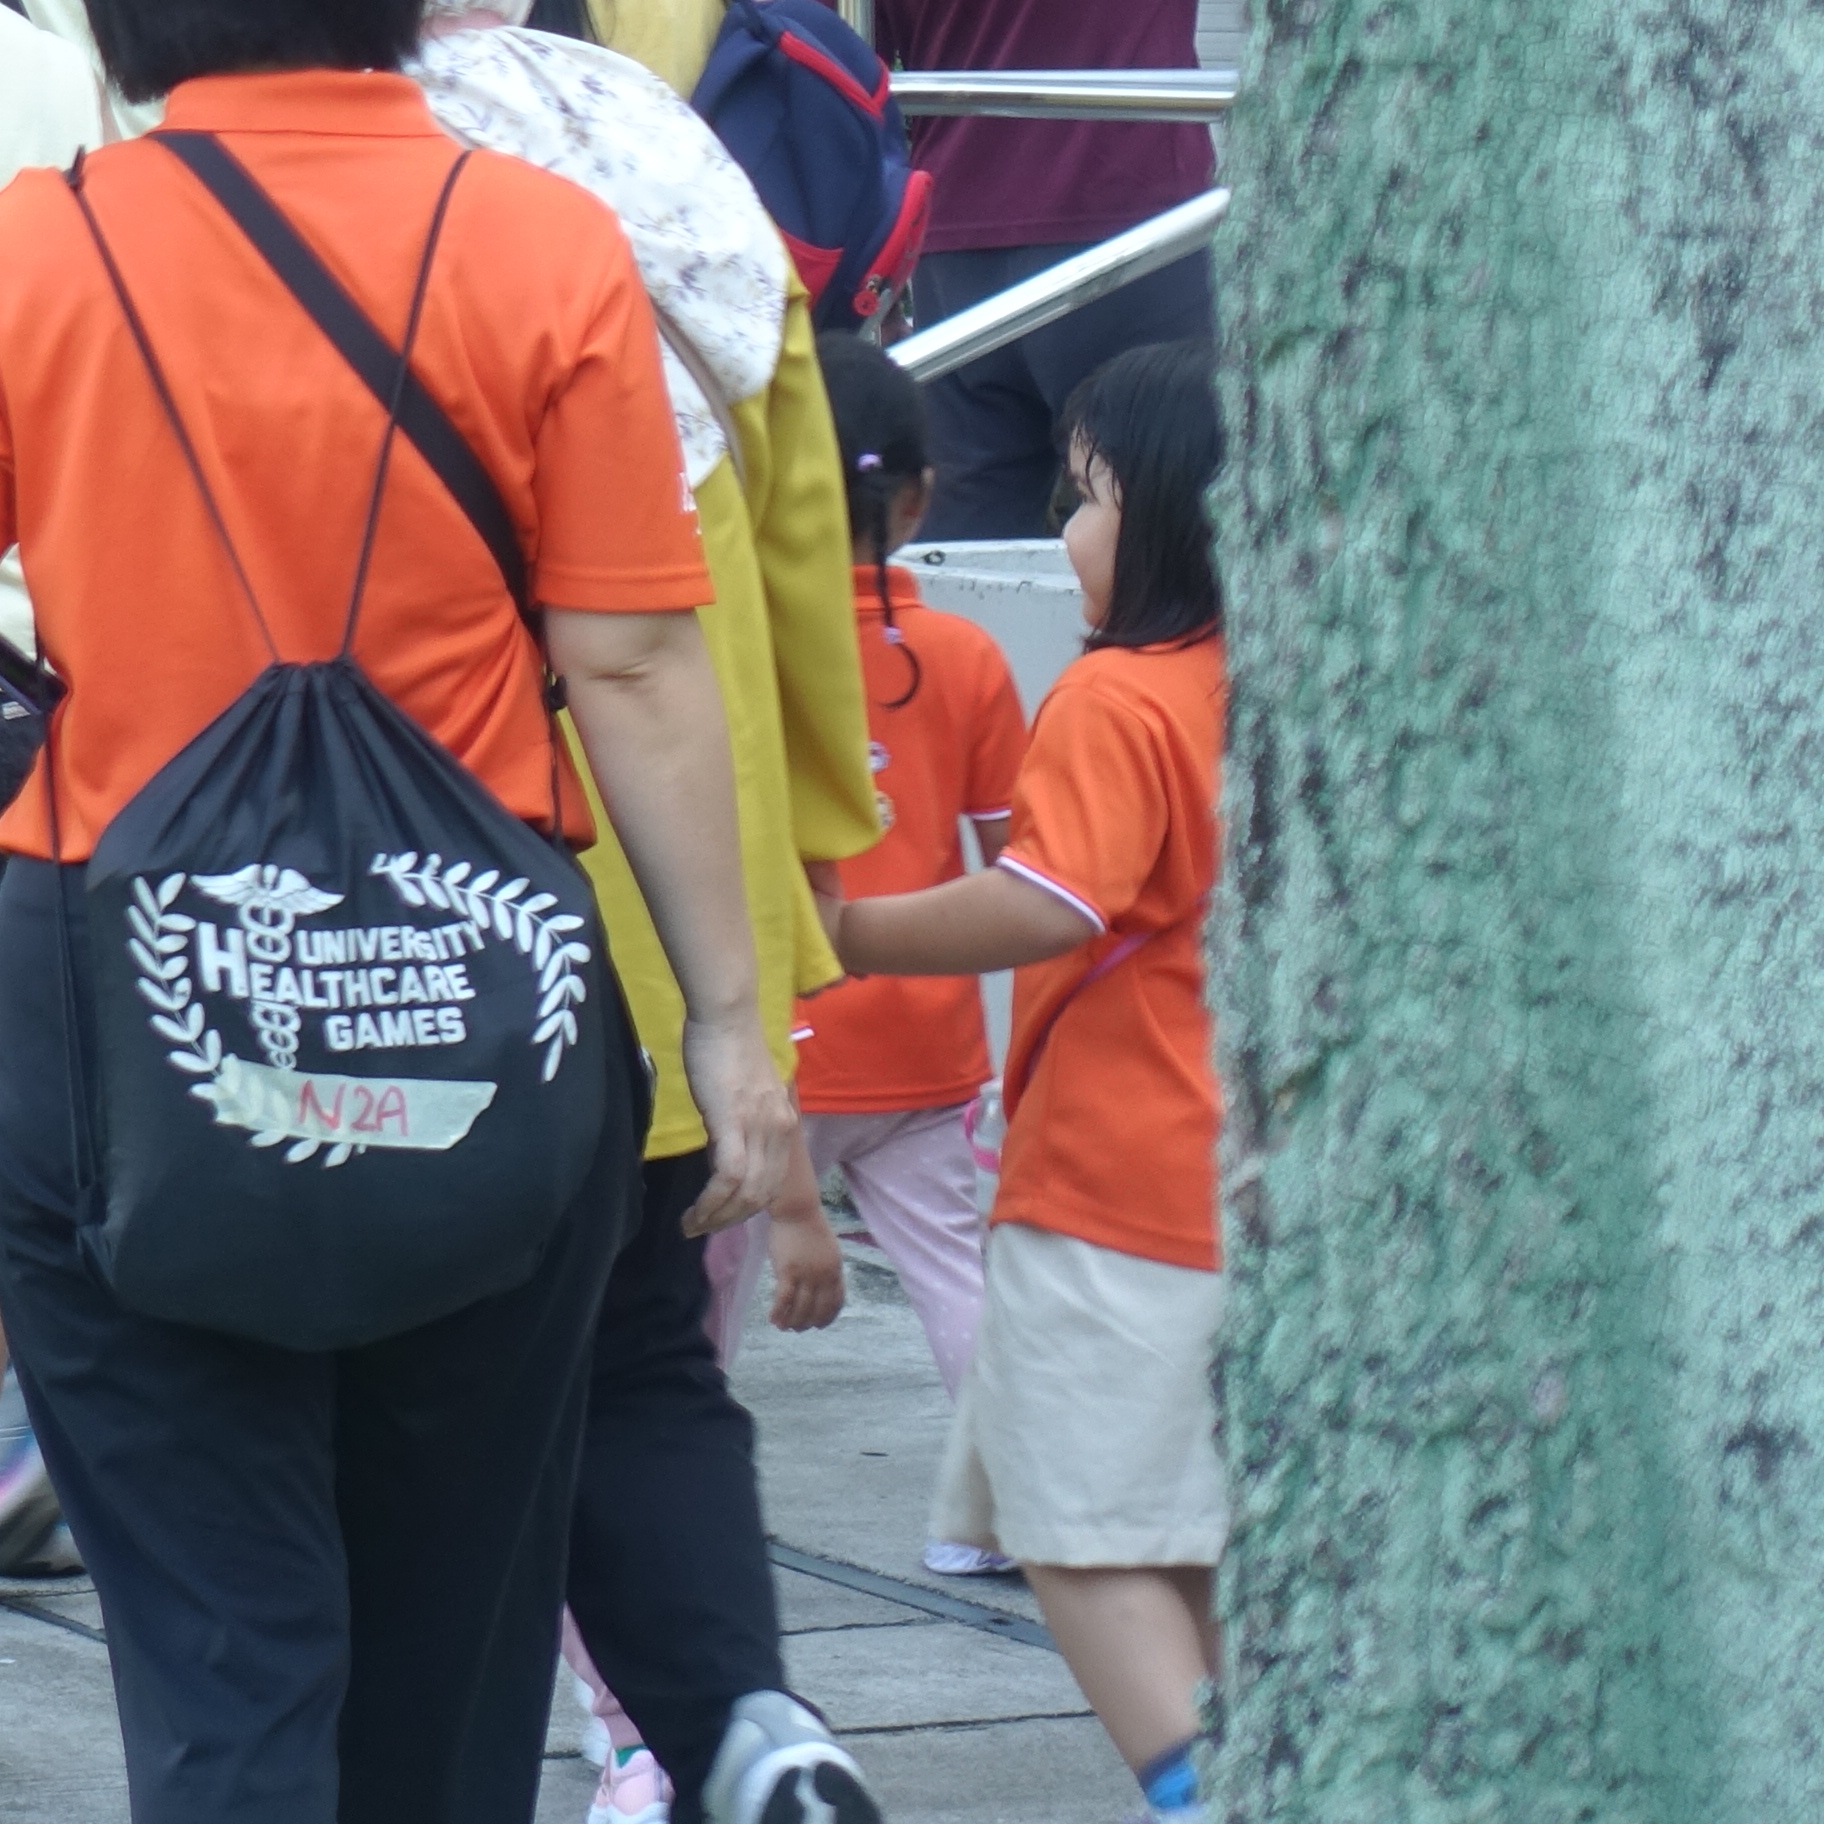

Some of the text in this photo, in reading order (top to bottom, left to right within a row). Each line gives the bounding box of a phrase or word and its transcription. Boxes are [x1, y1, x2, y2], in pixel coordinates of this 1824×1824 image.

[196, 924, 475, 1007] HEALTHCARE
[298, 924, 484, 966] UNIVERSITY
[326, 1010, 465, 1051] GAMES
